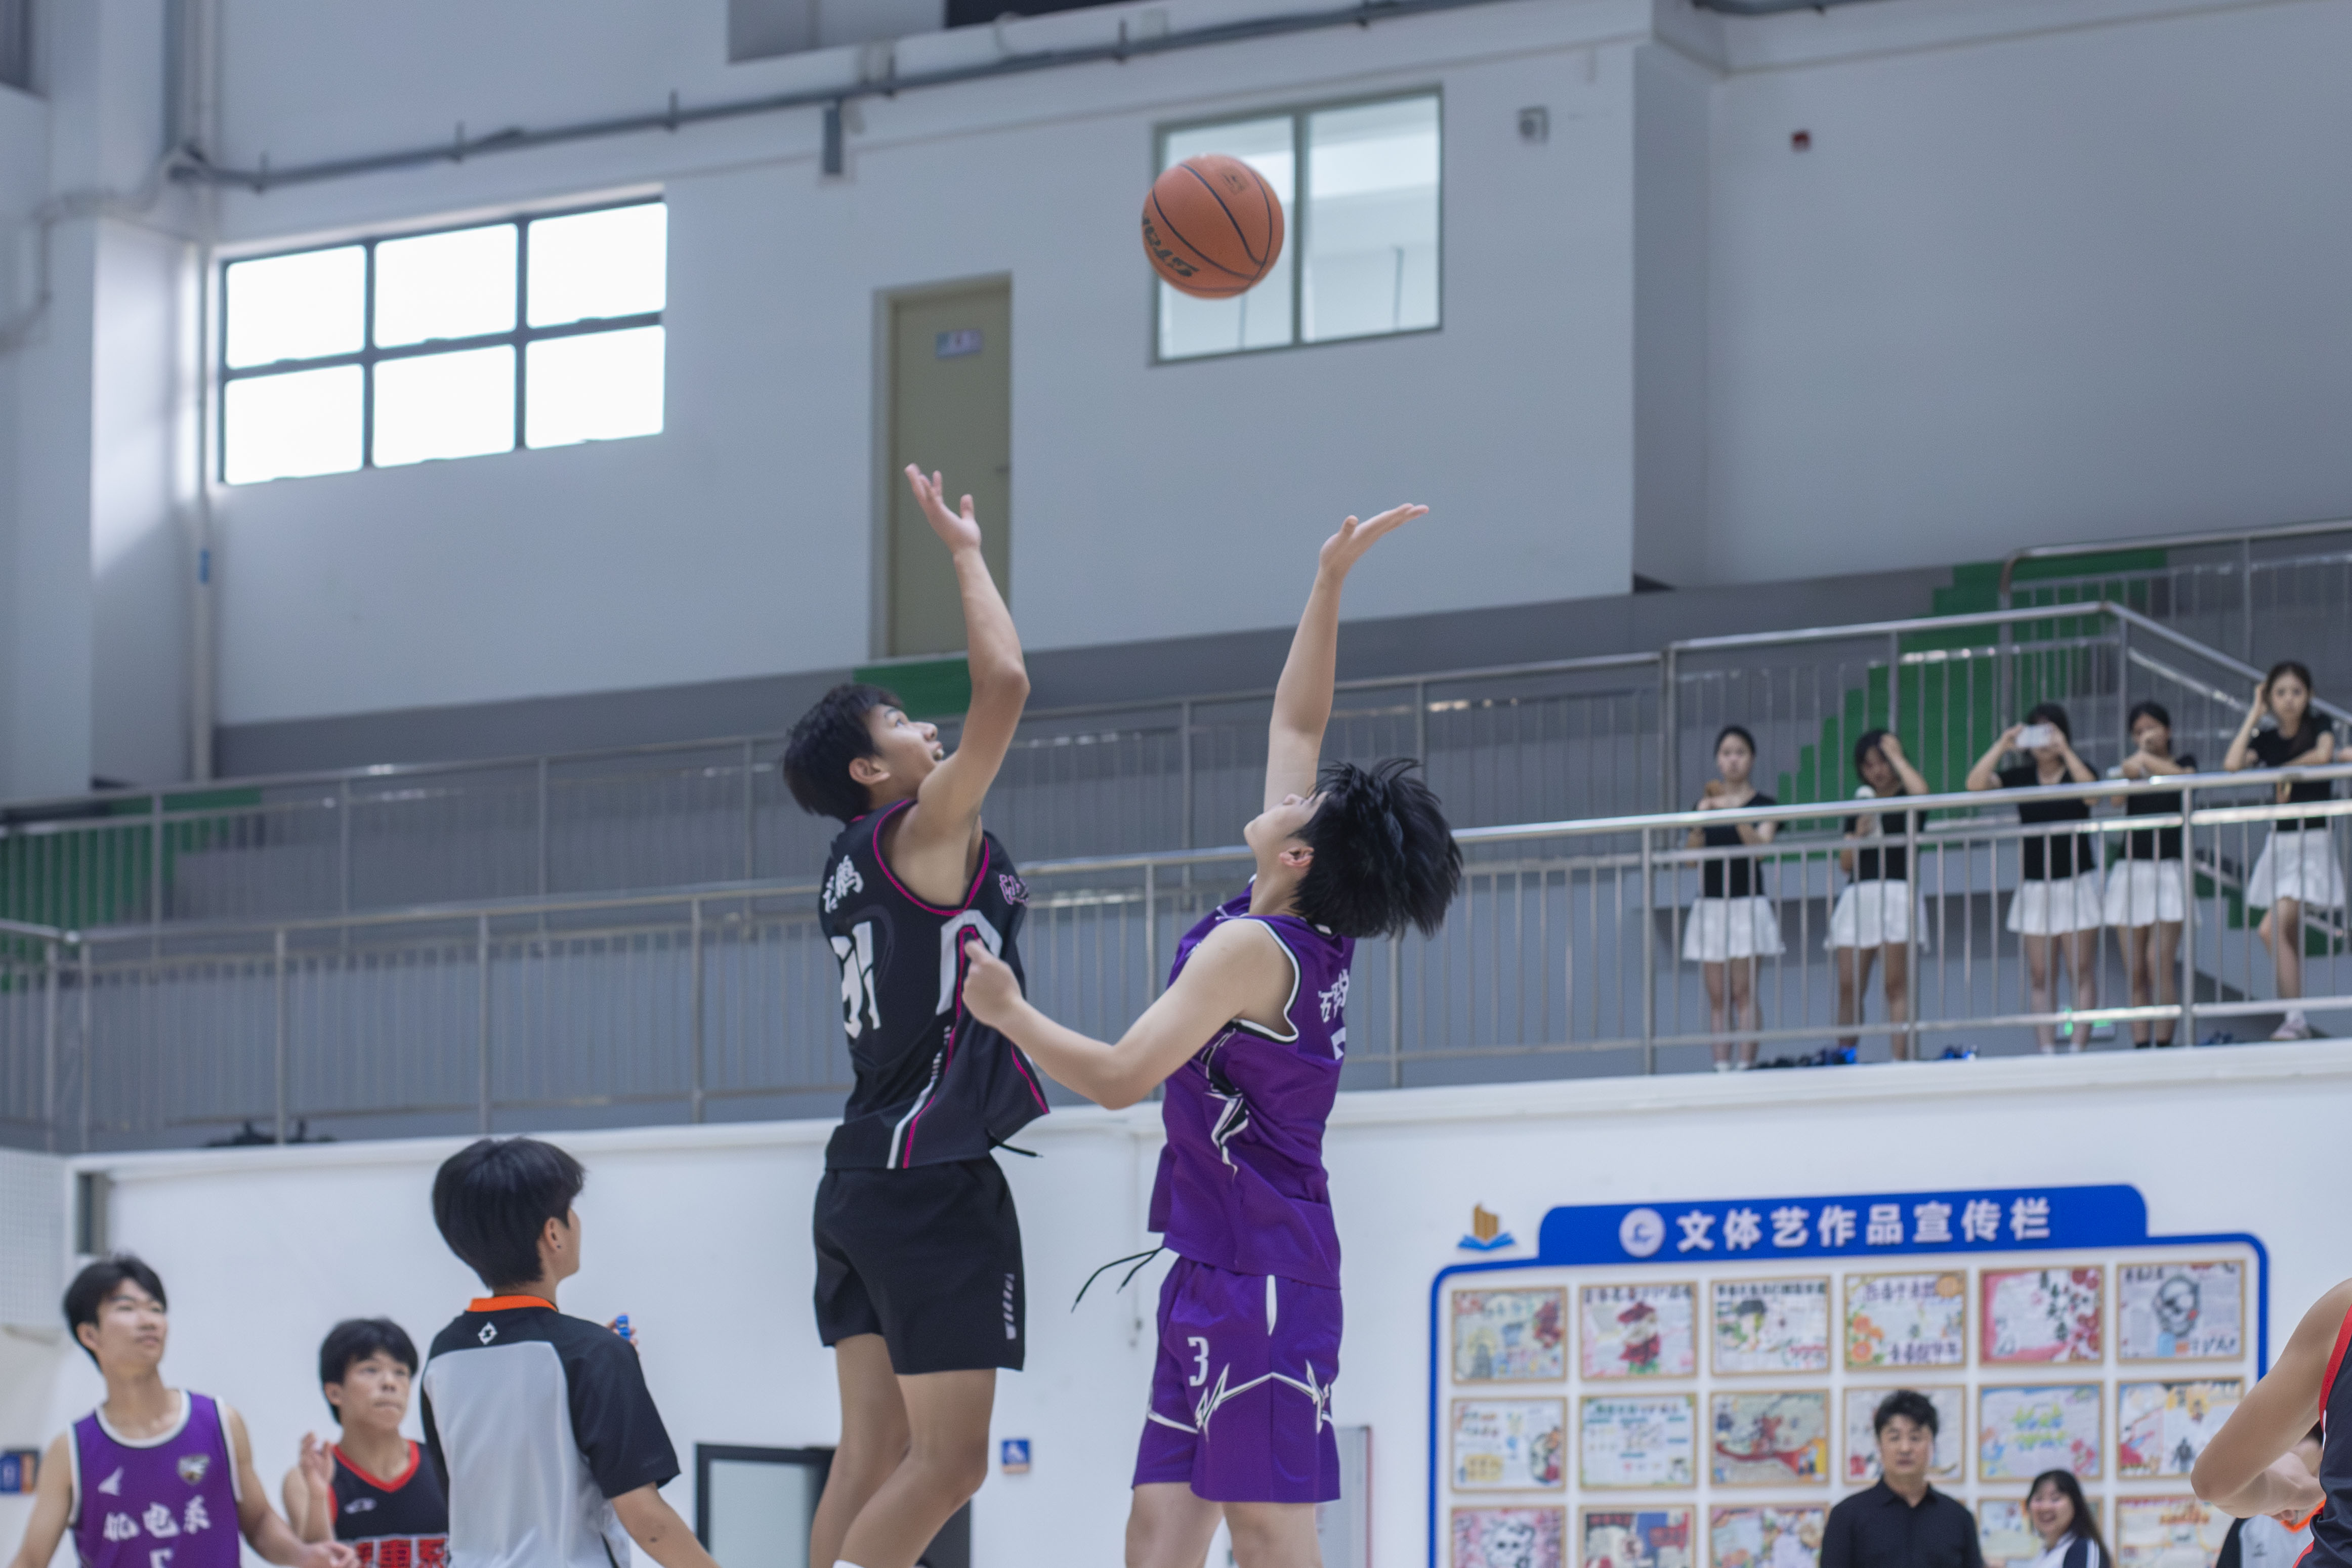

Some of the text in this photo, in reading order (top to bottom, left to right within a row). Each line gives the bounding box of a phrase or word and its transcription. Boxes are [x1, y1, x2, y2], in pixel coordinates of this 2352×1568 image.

[1676, 1197, 2050, 1252] 文体艺作品宣传栏
[1188, 1336, 1209, 1387] 3
